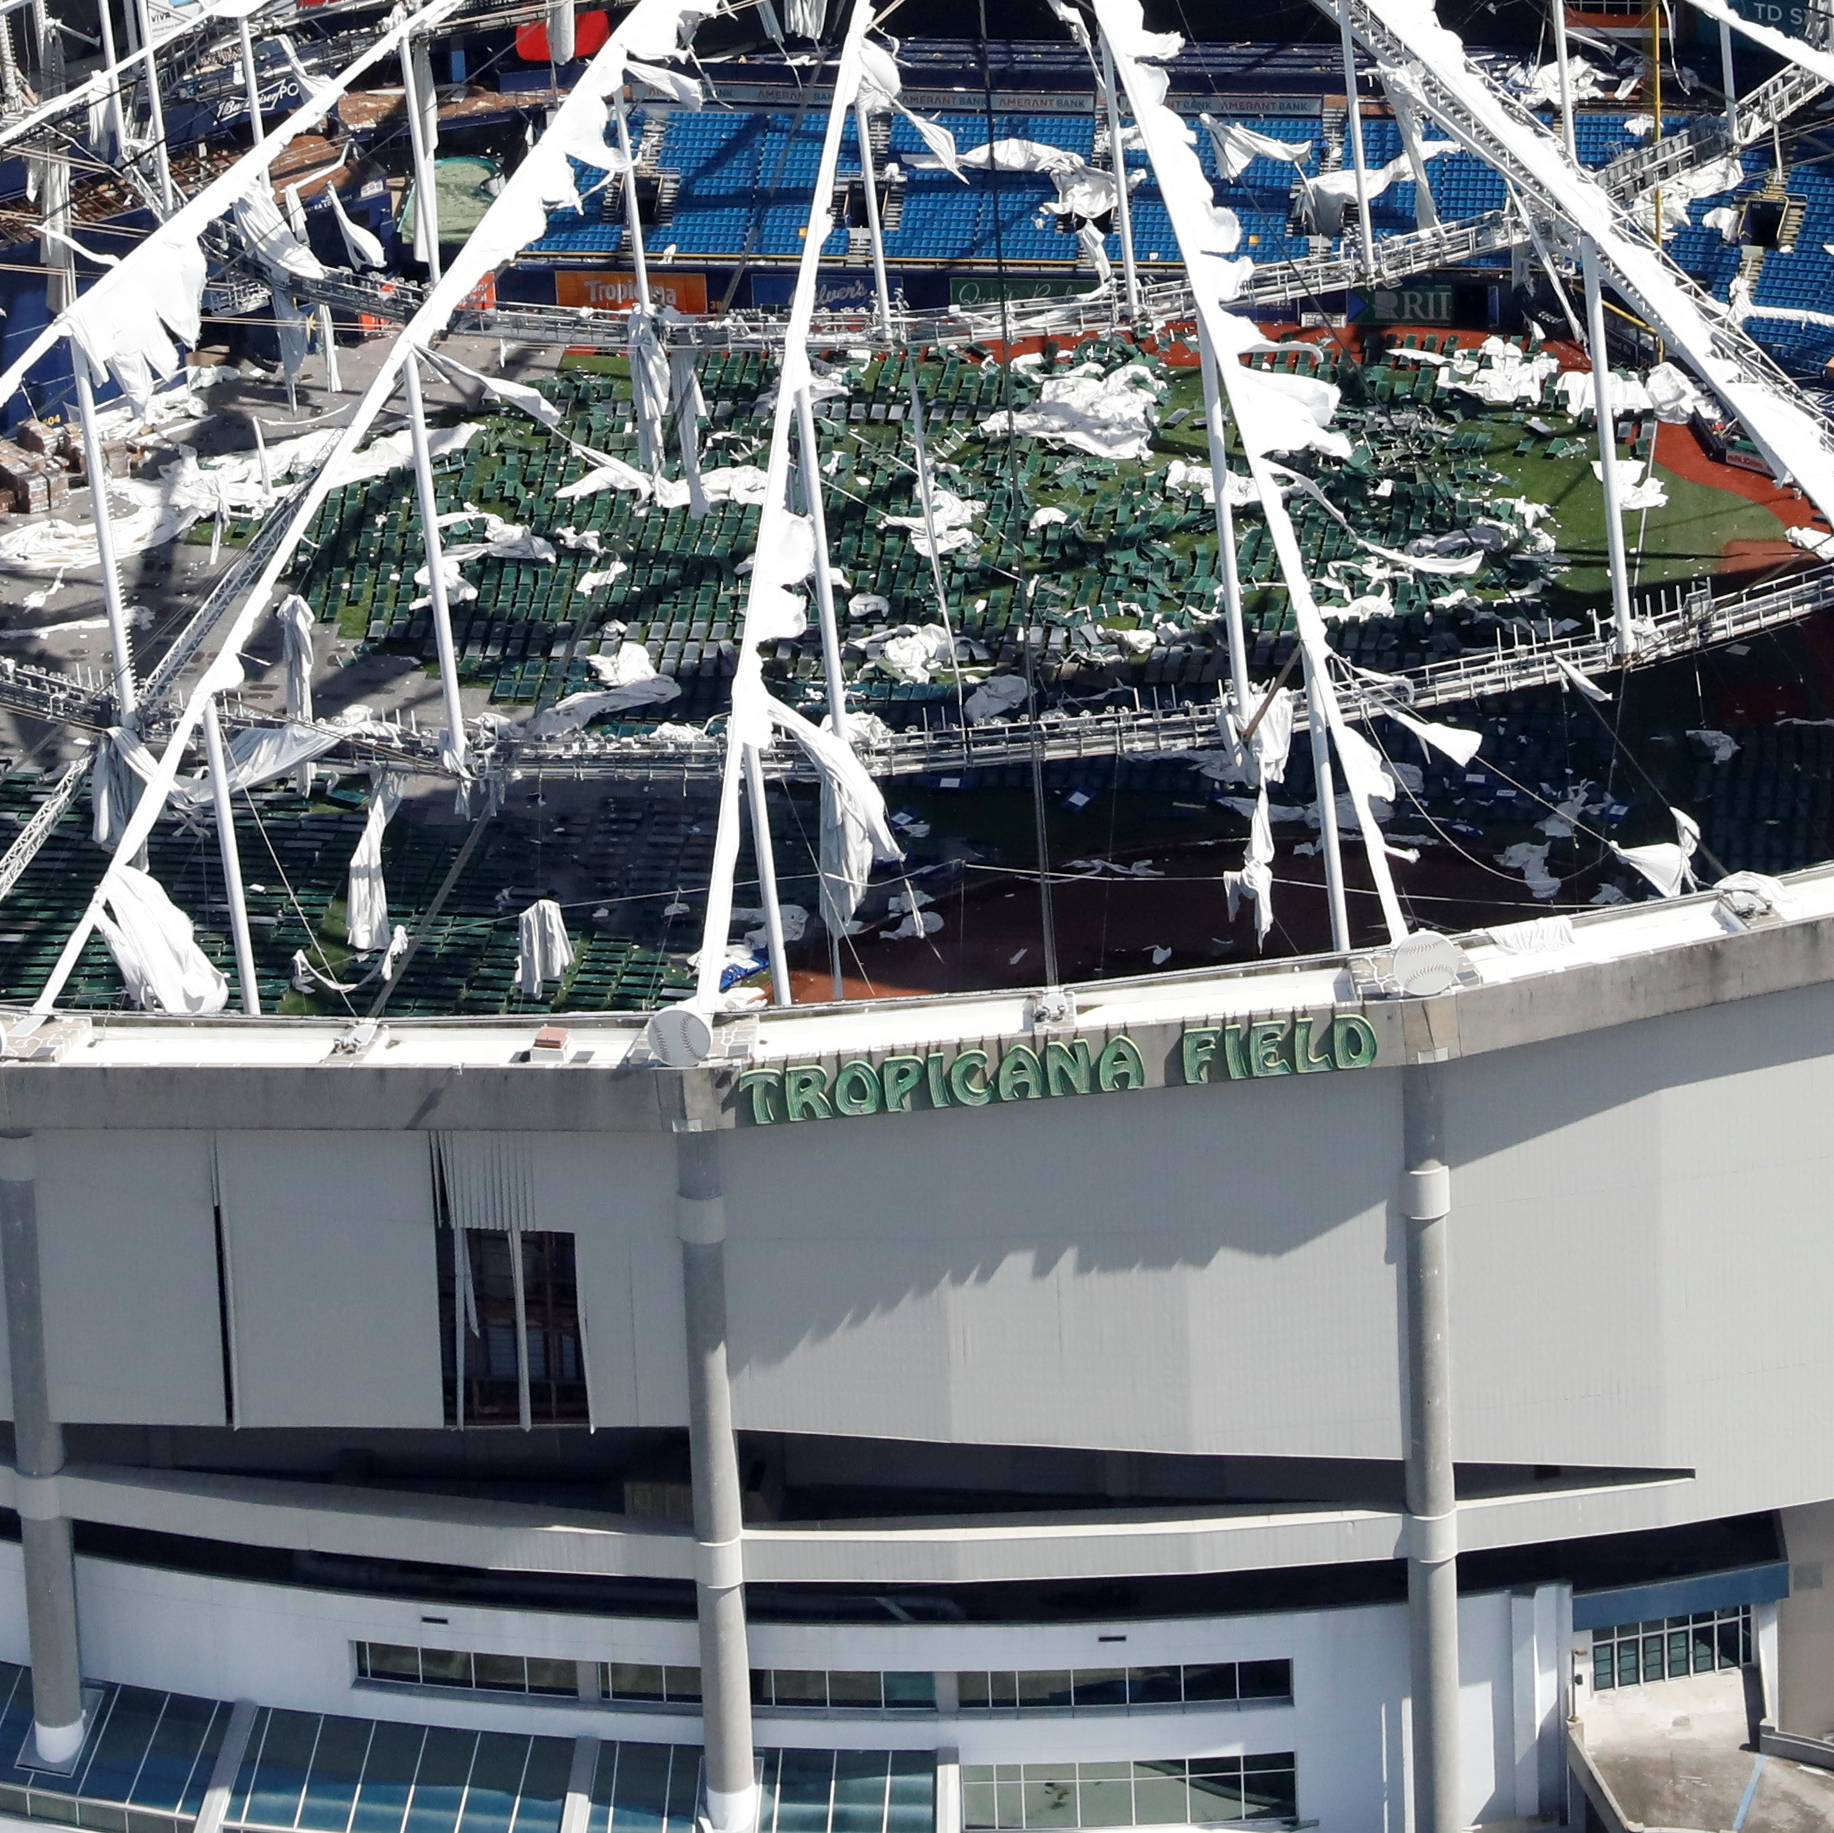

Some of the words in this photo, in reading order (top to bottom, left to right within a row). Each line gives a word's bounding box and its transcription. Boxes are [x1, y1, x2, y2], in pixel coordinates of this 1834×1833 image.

[1754, 2, 1782, 21] TD
[757, 90, 805, 101] AMERAN
[814, 93, 834, 101] BAN
[902, 95, 957, 106] AMERANT
[958, 97, 988, 107] BANK
[217, 92, 278, 117] Budiser
[999, 97, 1055, 108] AMERANT
[1056, 98, 1086, 109] BANK
[1183, 100, 1213, 110] BANK
[1220, 100, 1277, 111] AMERANT
[1278, 101, 1308, 112] BANK
[583, 279, 677, 306] Tropicna
[738, 1033, 1145, 1126] TROPICANA
[1182, 1012, 1379, 1086] FIELD
